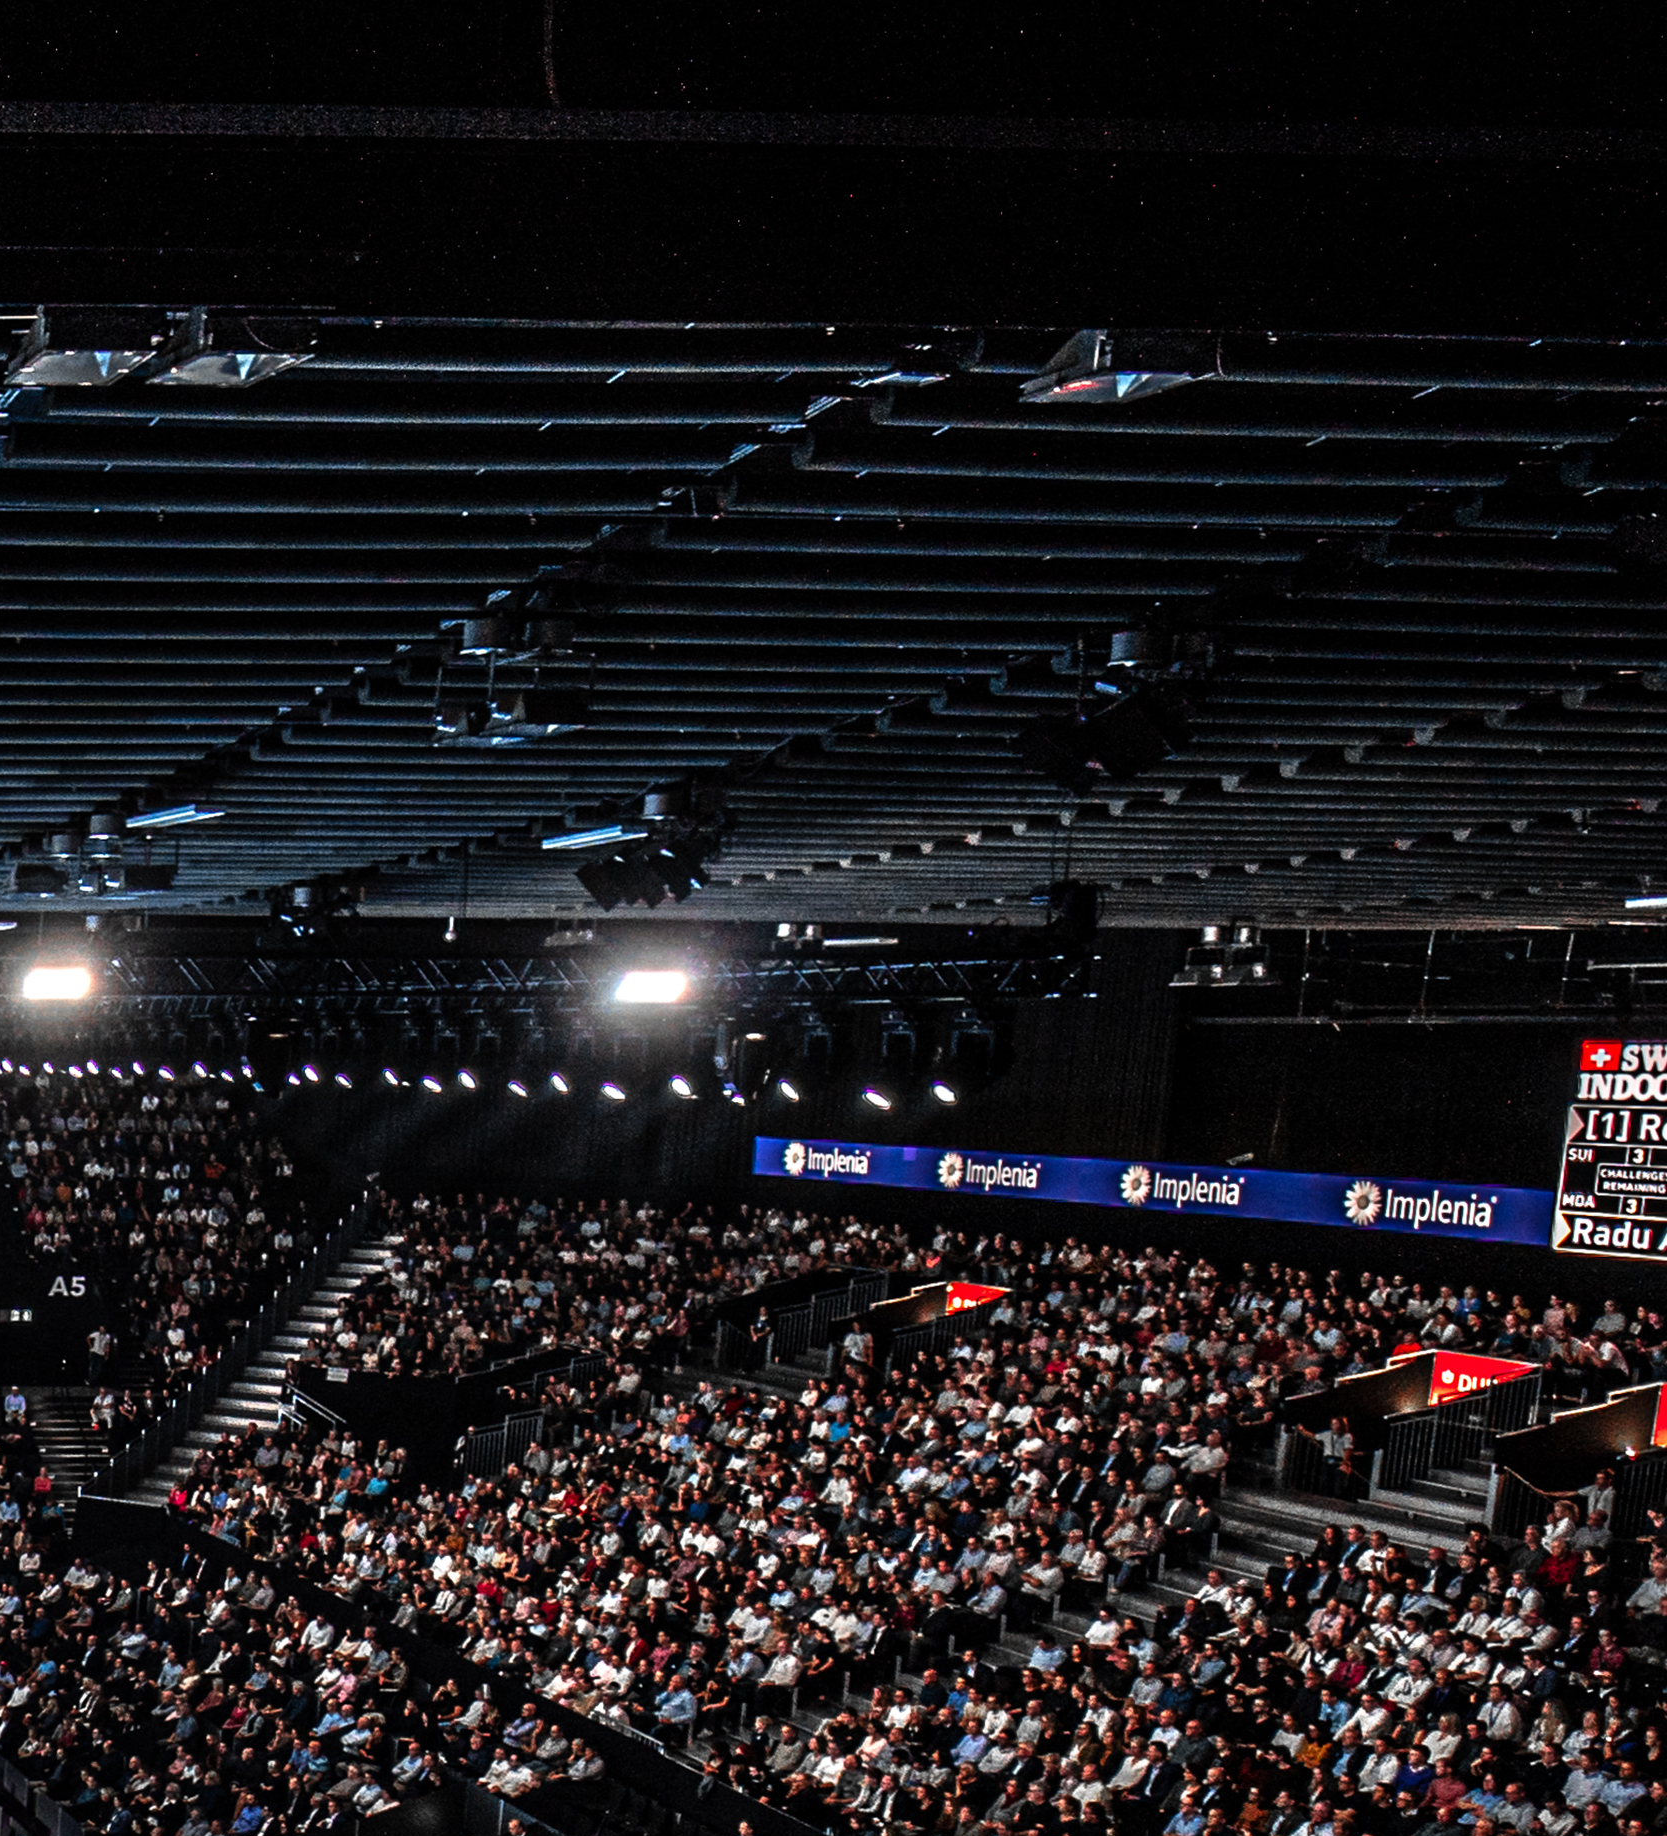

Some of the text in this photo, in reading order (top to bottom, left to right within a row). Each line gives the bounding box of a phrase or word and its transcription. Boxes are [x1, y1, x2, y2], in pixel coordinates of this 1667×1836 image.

[1586, 1110, 1630, 1142] [1]
[807, 1148, 870, 1178] Implenia
[1568, 1148, 1593, 1162] SUI
[1632, 1149, 1645, 1164] 3
[966, 1158, 1040, 1192] Implenia
[1153, 1172, 1245, 1208] Implenia
[1385, 1188, 1498, 1230] Implenia
[1625, 1199, 1638, 1214] 3
[1572, 1217, 1652, 1250] Radu
[48, 1275, 86, 1297] A5
